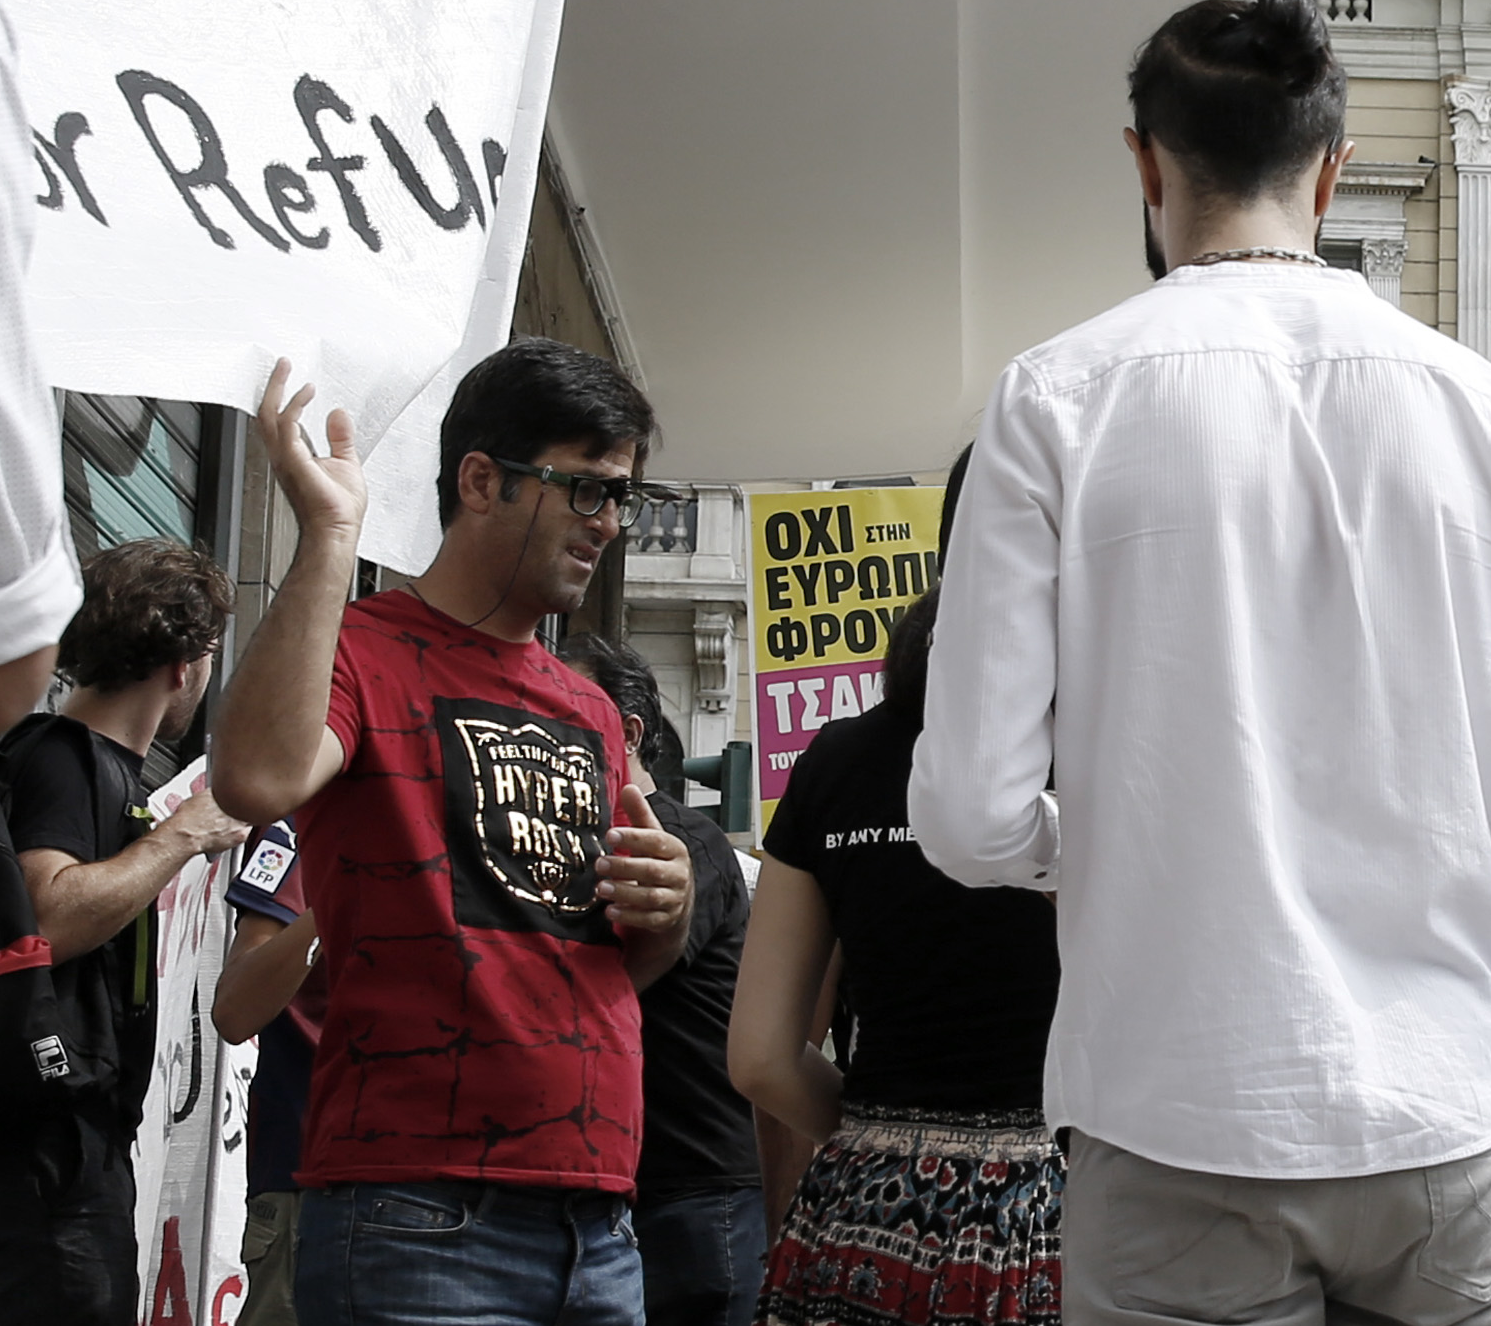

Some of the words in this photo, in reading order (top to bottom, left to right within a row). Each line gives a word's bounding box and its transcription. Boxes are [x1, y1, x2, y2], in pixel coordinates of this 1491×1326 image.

[764, 504, 855, 562] ΟΧΙ
[865, 522, 911, 544] ΣΤΗΝ
[768, 749, 808, 771] ΤΟΥ
[825, 832, 845, 849] BY
[847, 828, 884, 846] ANY
[248, 867, 274, 884] LFP
